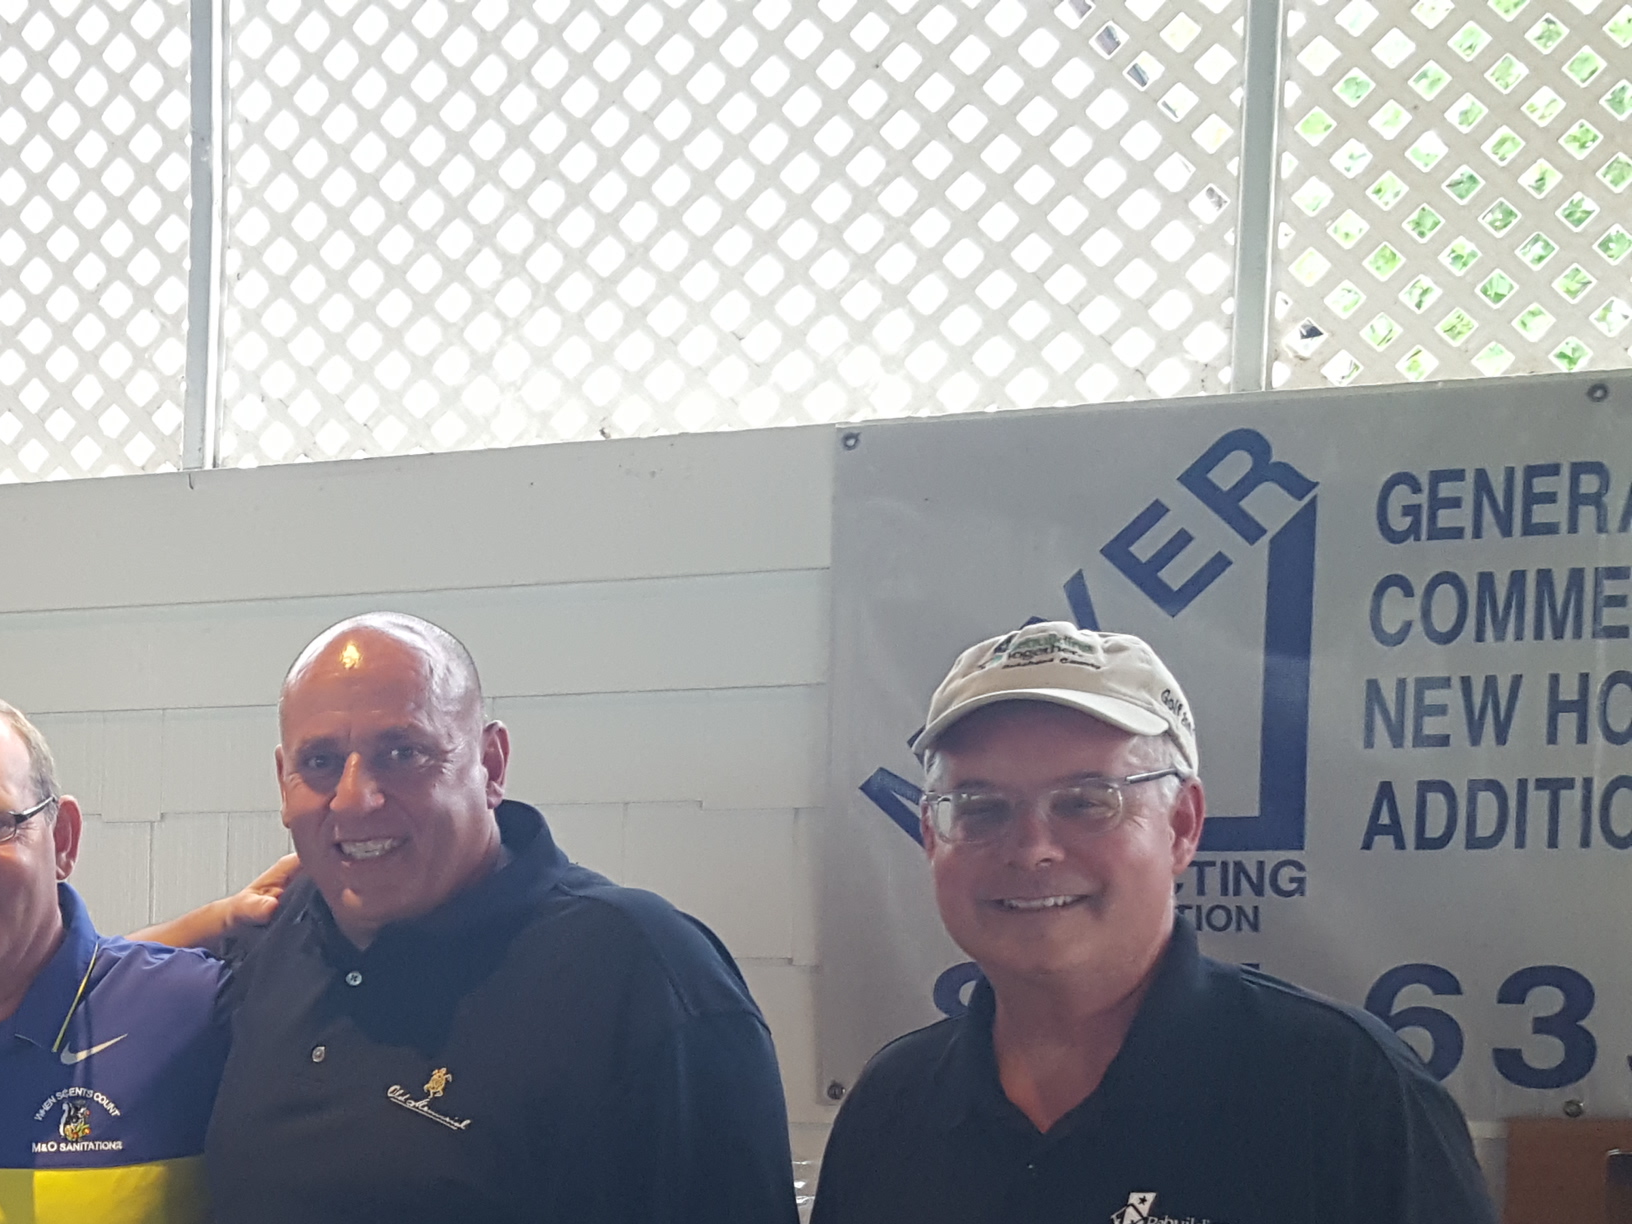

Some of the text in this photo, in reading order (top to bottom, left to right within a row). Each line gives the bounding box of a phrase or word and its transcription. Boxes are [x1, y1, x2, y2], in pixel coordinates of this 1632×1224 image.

[1362, 673, 1523, 749] NEW
[1175, 859, 1307, 899] TING
[34, 1087, 121, 1121] WHEN SCENTS COUNT
[31, 1141, 58, 1153] M&O
